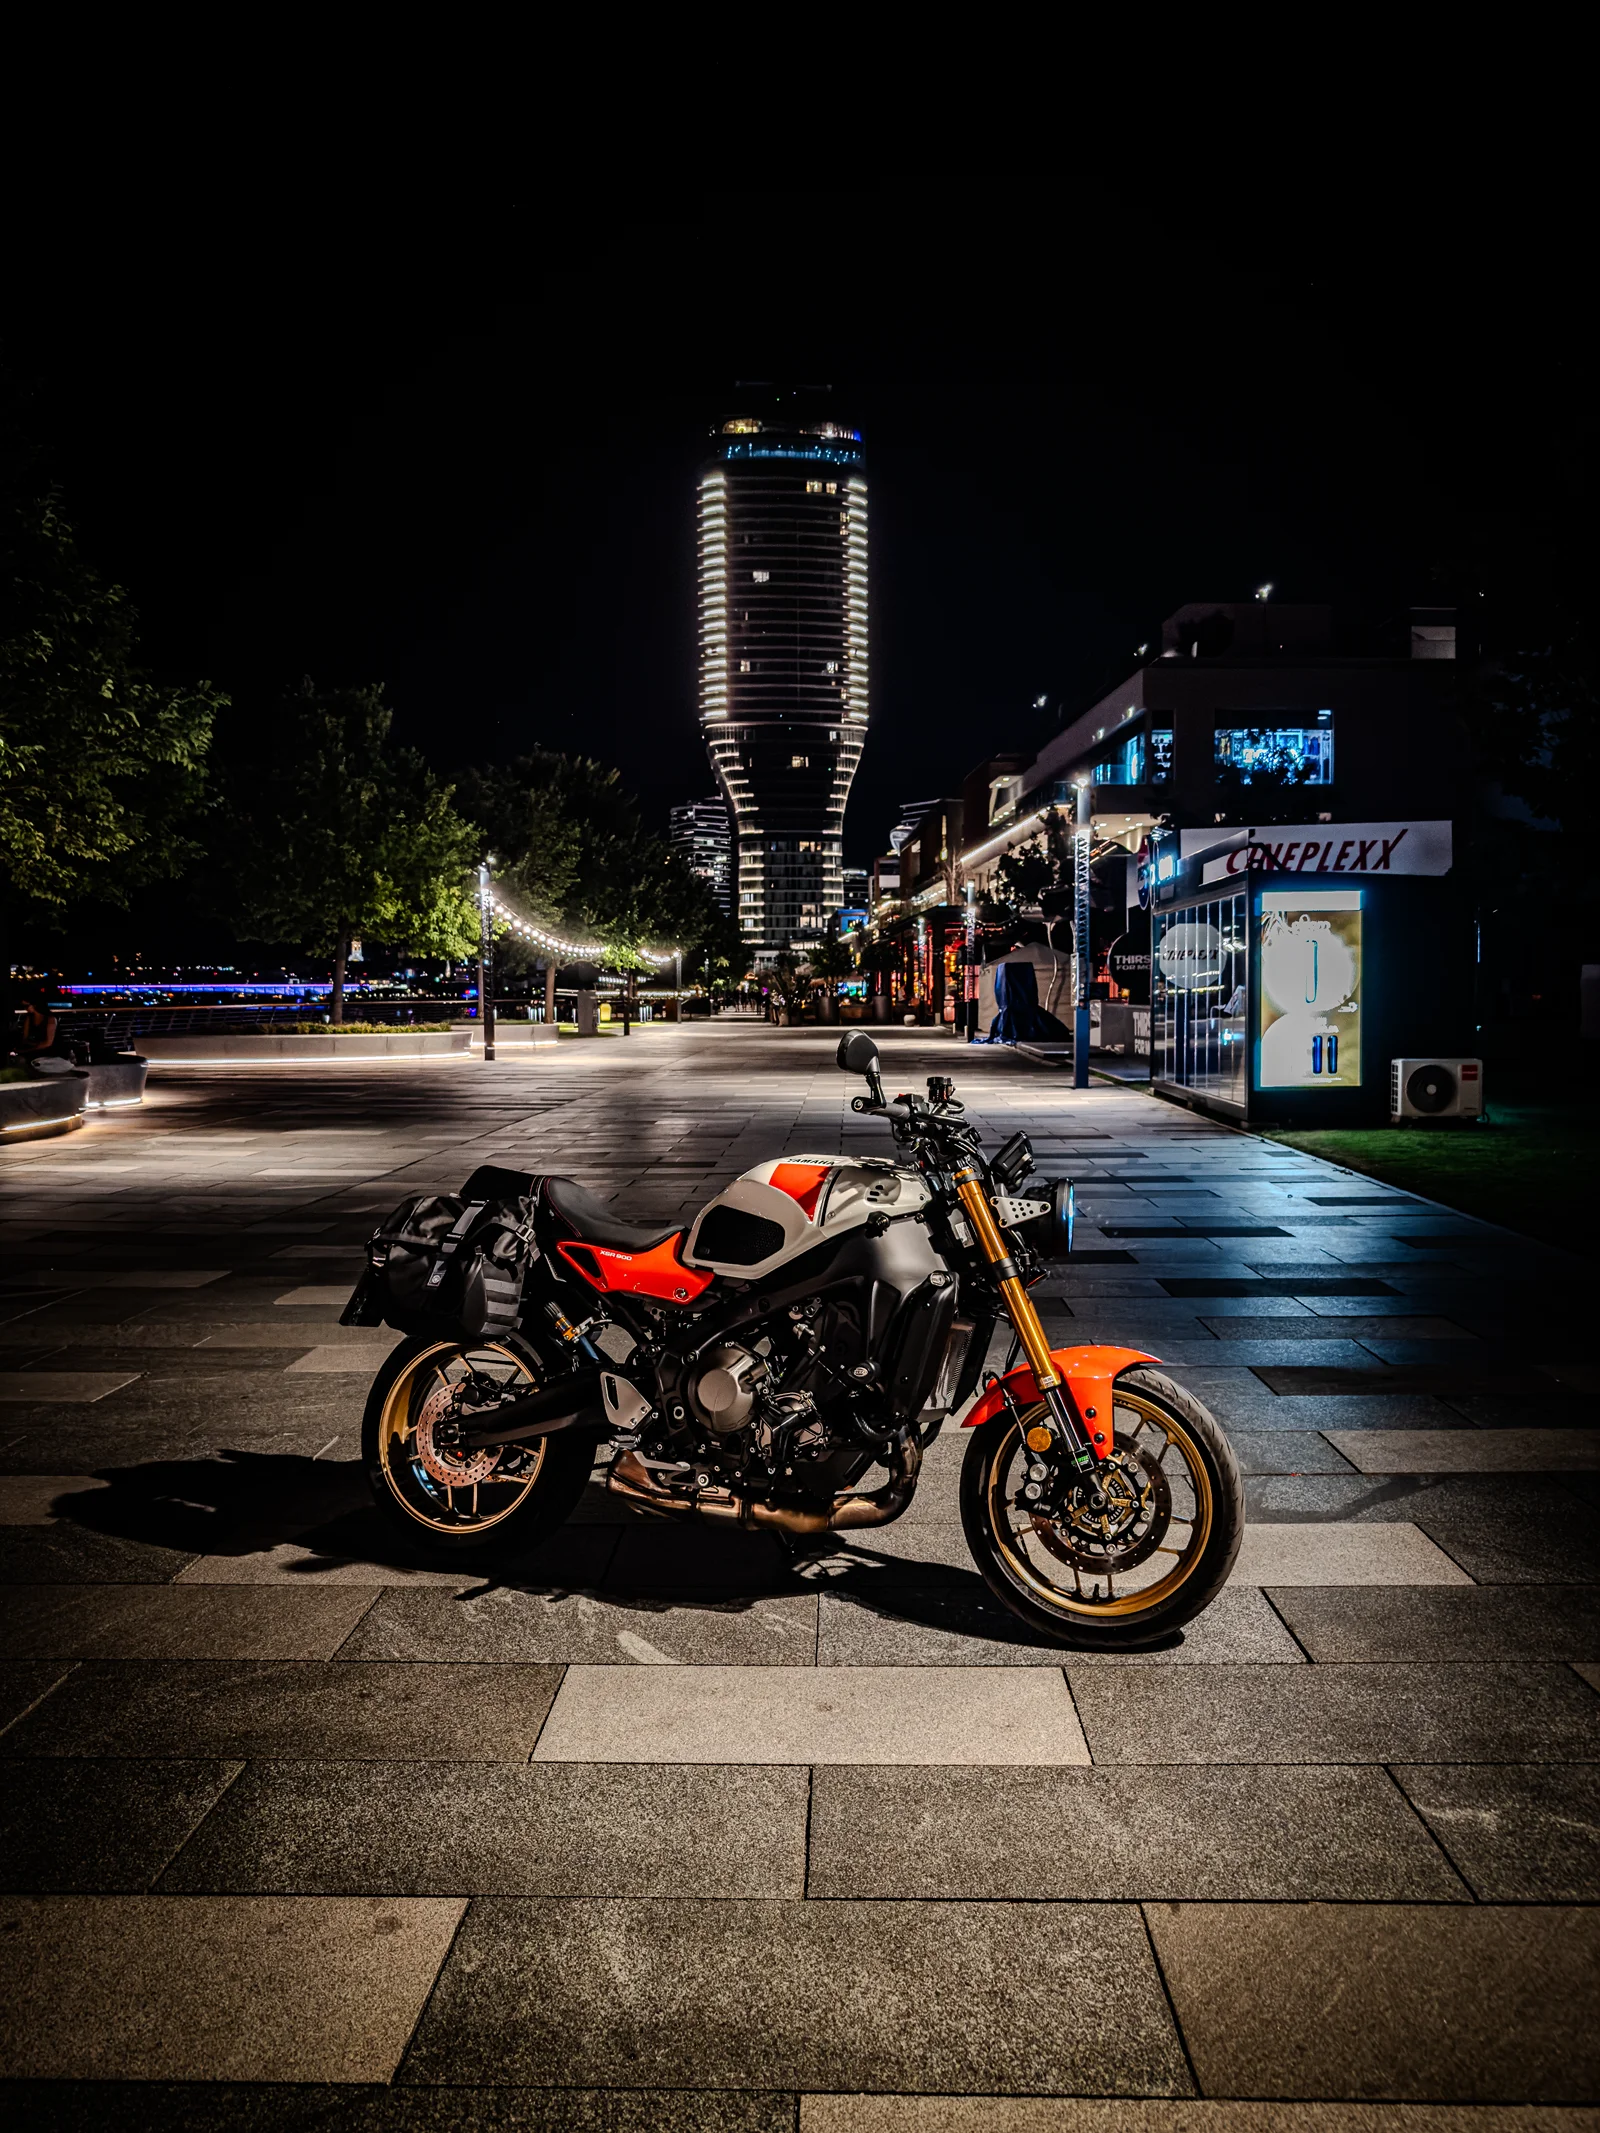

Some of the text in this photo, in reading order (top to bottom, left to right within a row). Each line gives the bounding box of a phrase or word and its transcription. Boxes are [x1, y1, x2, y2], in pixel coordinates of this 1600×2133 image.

[1226, 828, 1409, 874] CINEPLEXX
[787, 1158, 835, 1166] YAMAHA
[600, 1249, 633, 1261] XSR 900
